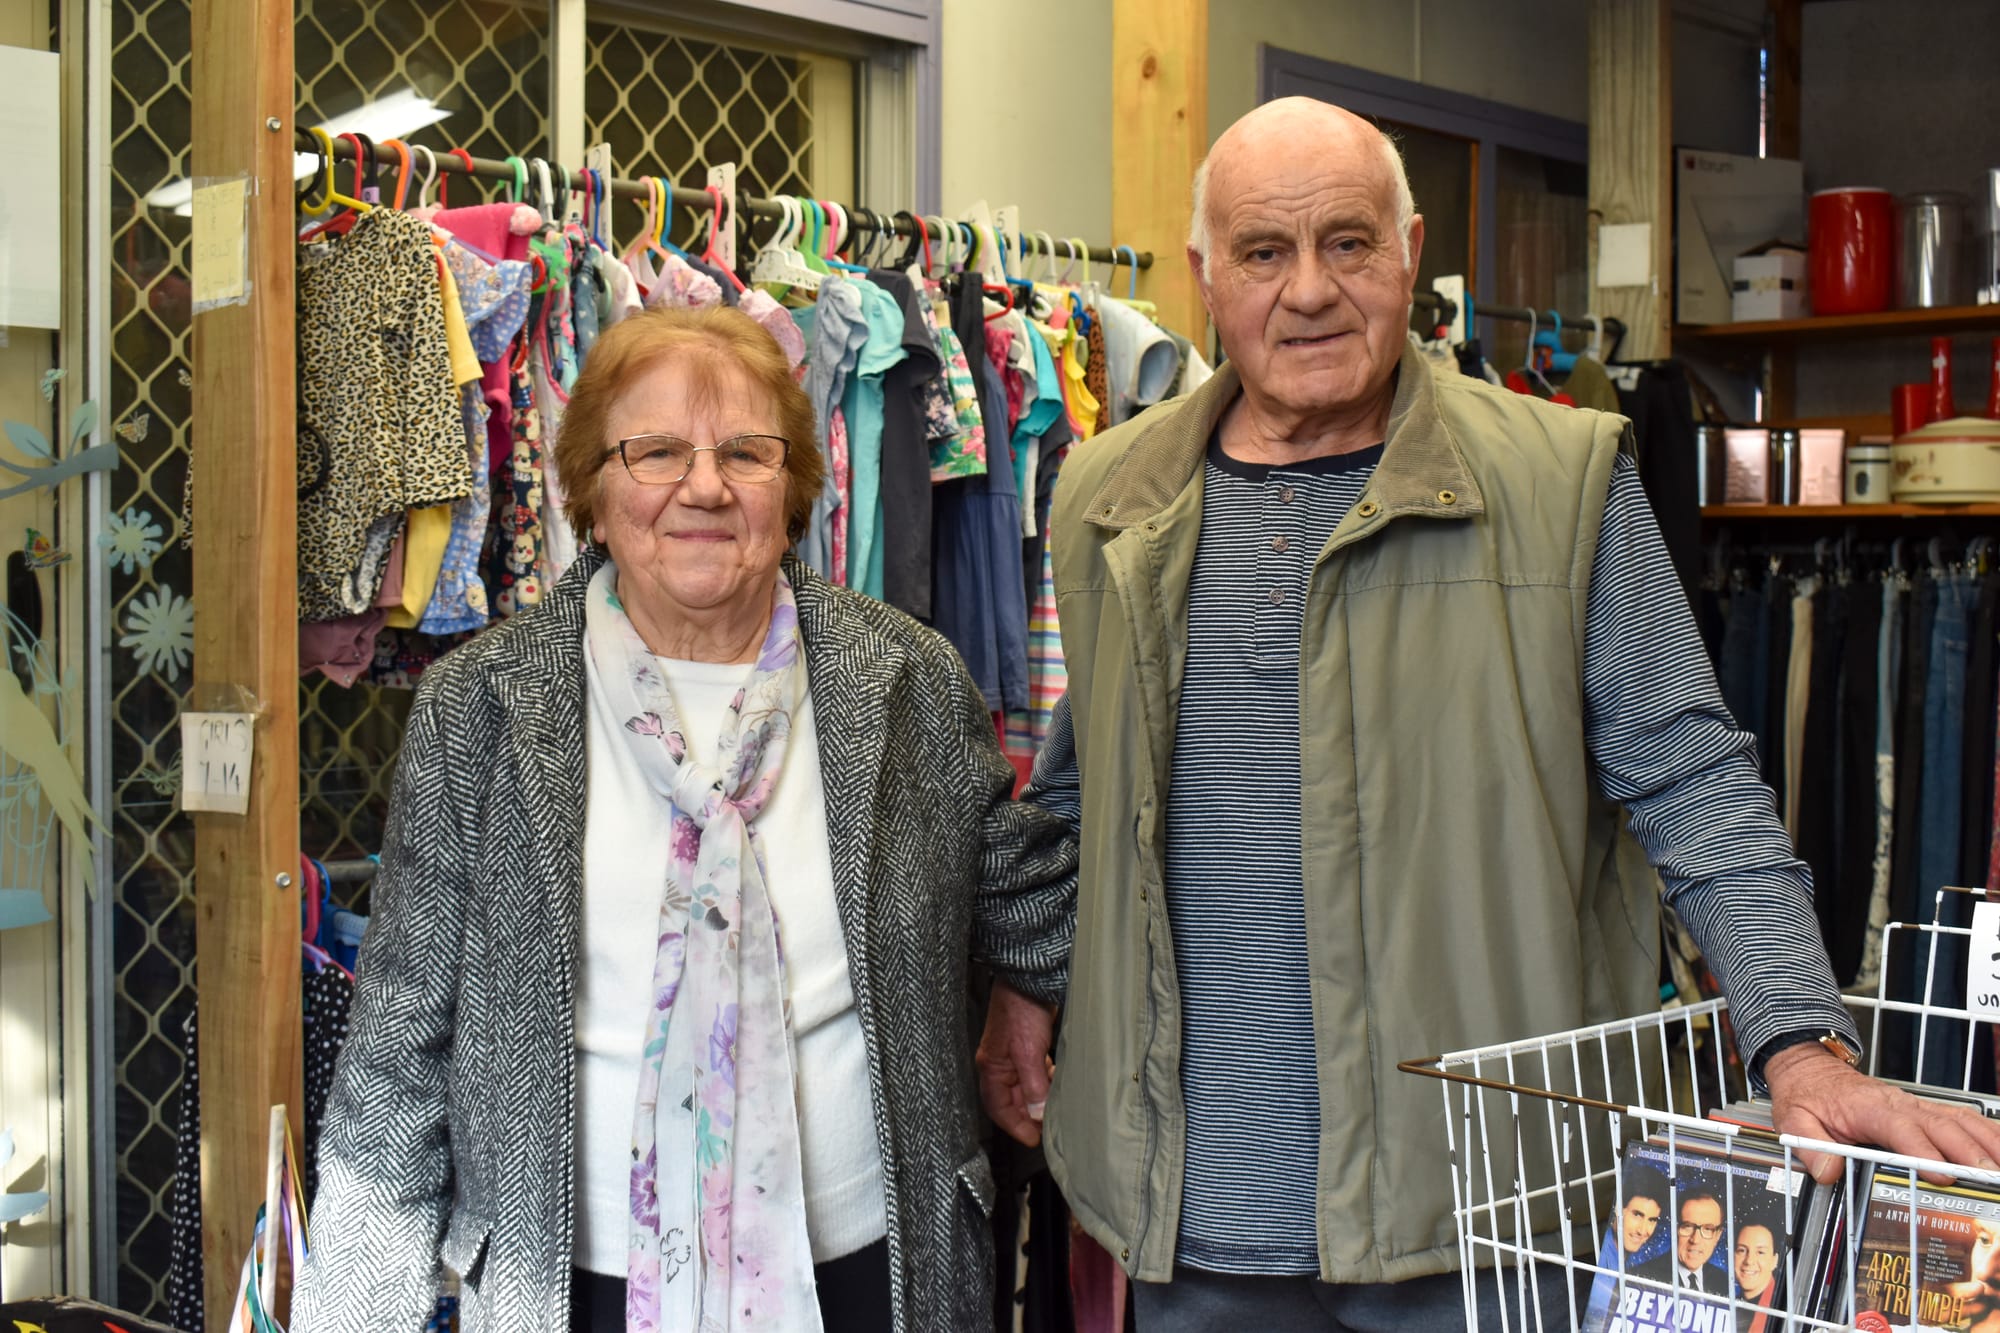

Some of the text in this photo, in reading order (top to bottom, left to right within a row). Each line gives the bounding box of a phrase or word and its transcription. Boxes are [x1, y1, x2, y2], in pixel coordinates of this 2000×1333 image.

[1920, 1195, 1985, 1214] DOUBLE
[1885, 1208, 1928, 1227] ANTHNY
[1931, 1216, 1971, 1235] HOPKINS
[1866, 1279, 1882, 1297] OF
[1616, 1286, 1733, 1333] BEYOND
